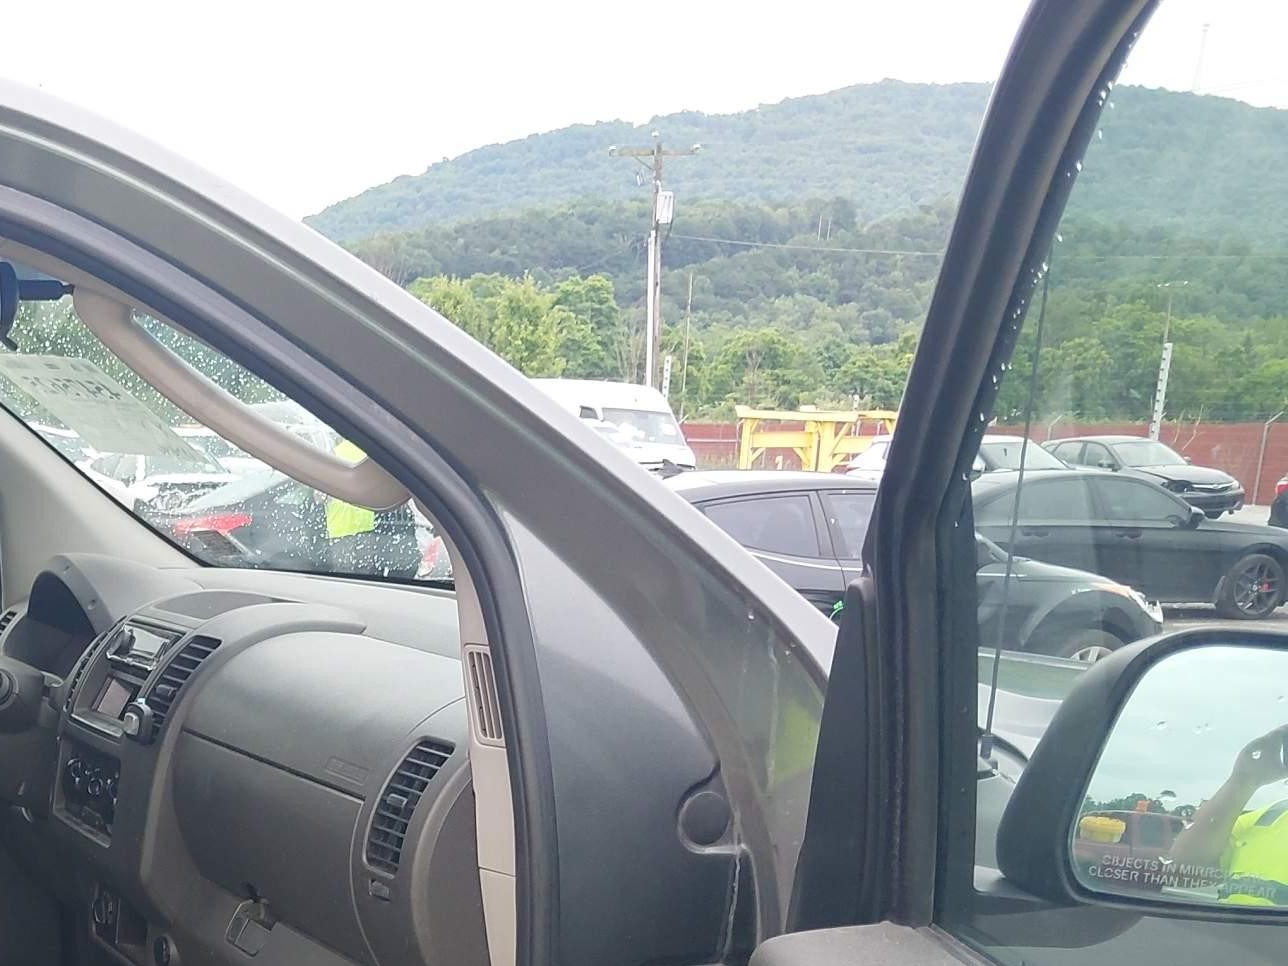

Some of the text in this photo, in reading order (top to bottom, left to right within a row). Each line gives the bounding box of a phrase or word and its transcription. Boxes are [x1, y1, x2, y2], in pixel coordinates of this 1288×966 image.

[1102, 854, 1159, 871] OBJECTS
[1162, 862, 1178, 874] IN
[1088, 865, 1138, 881] CLOSER
[1143, 872, 1178, 888] THAN
